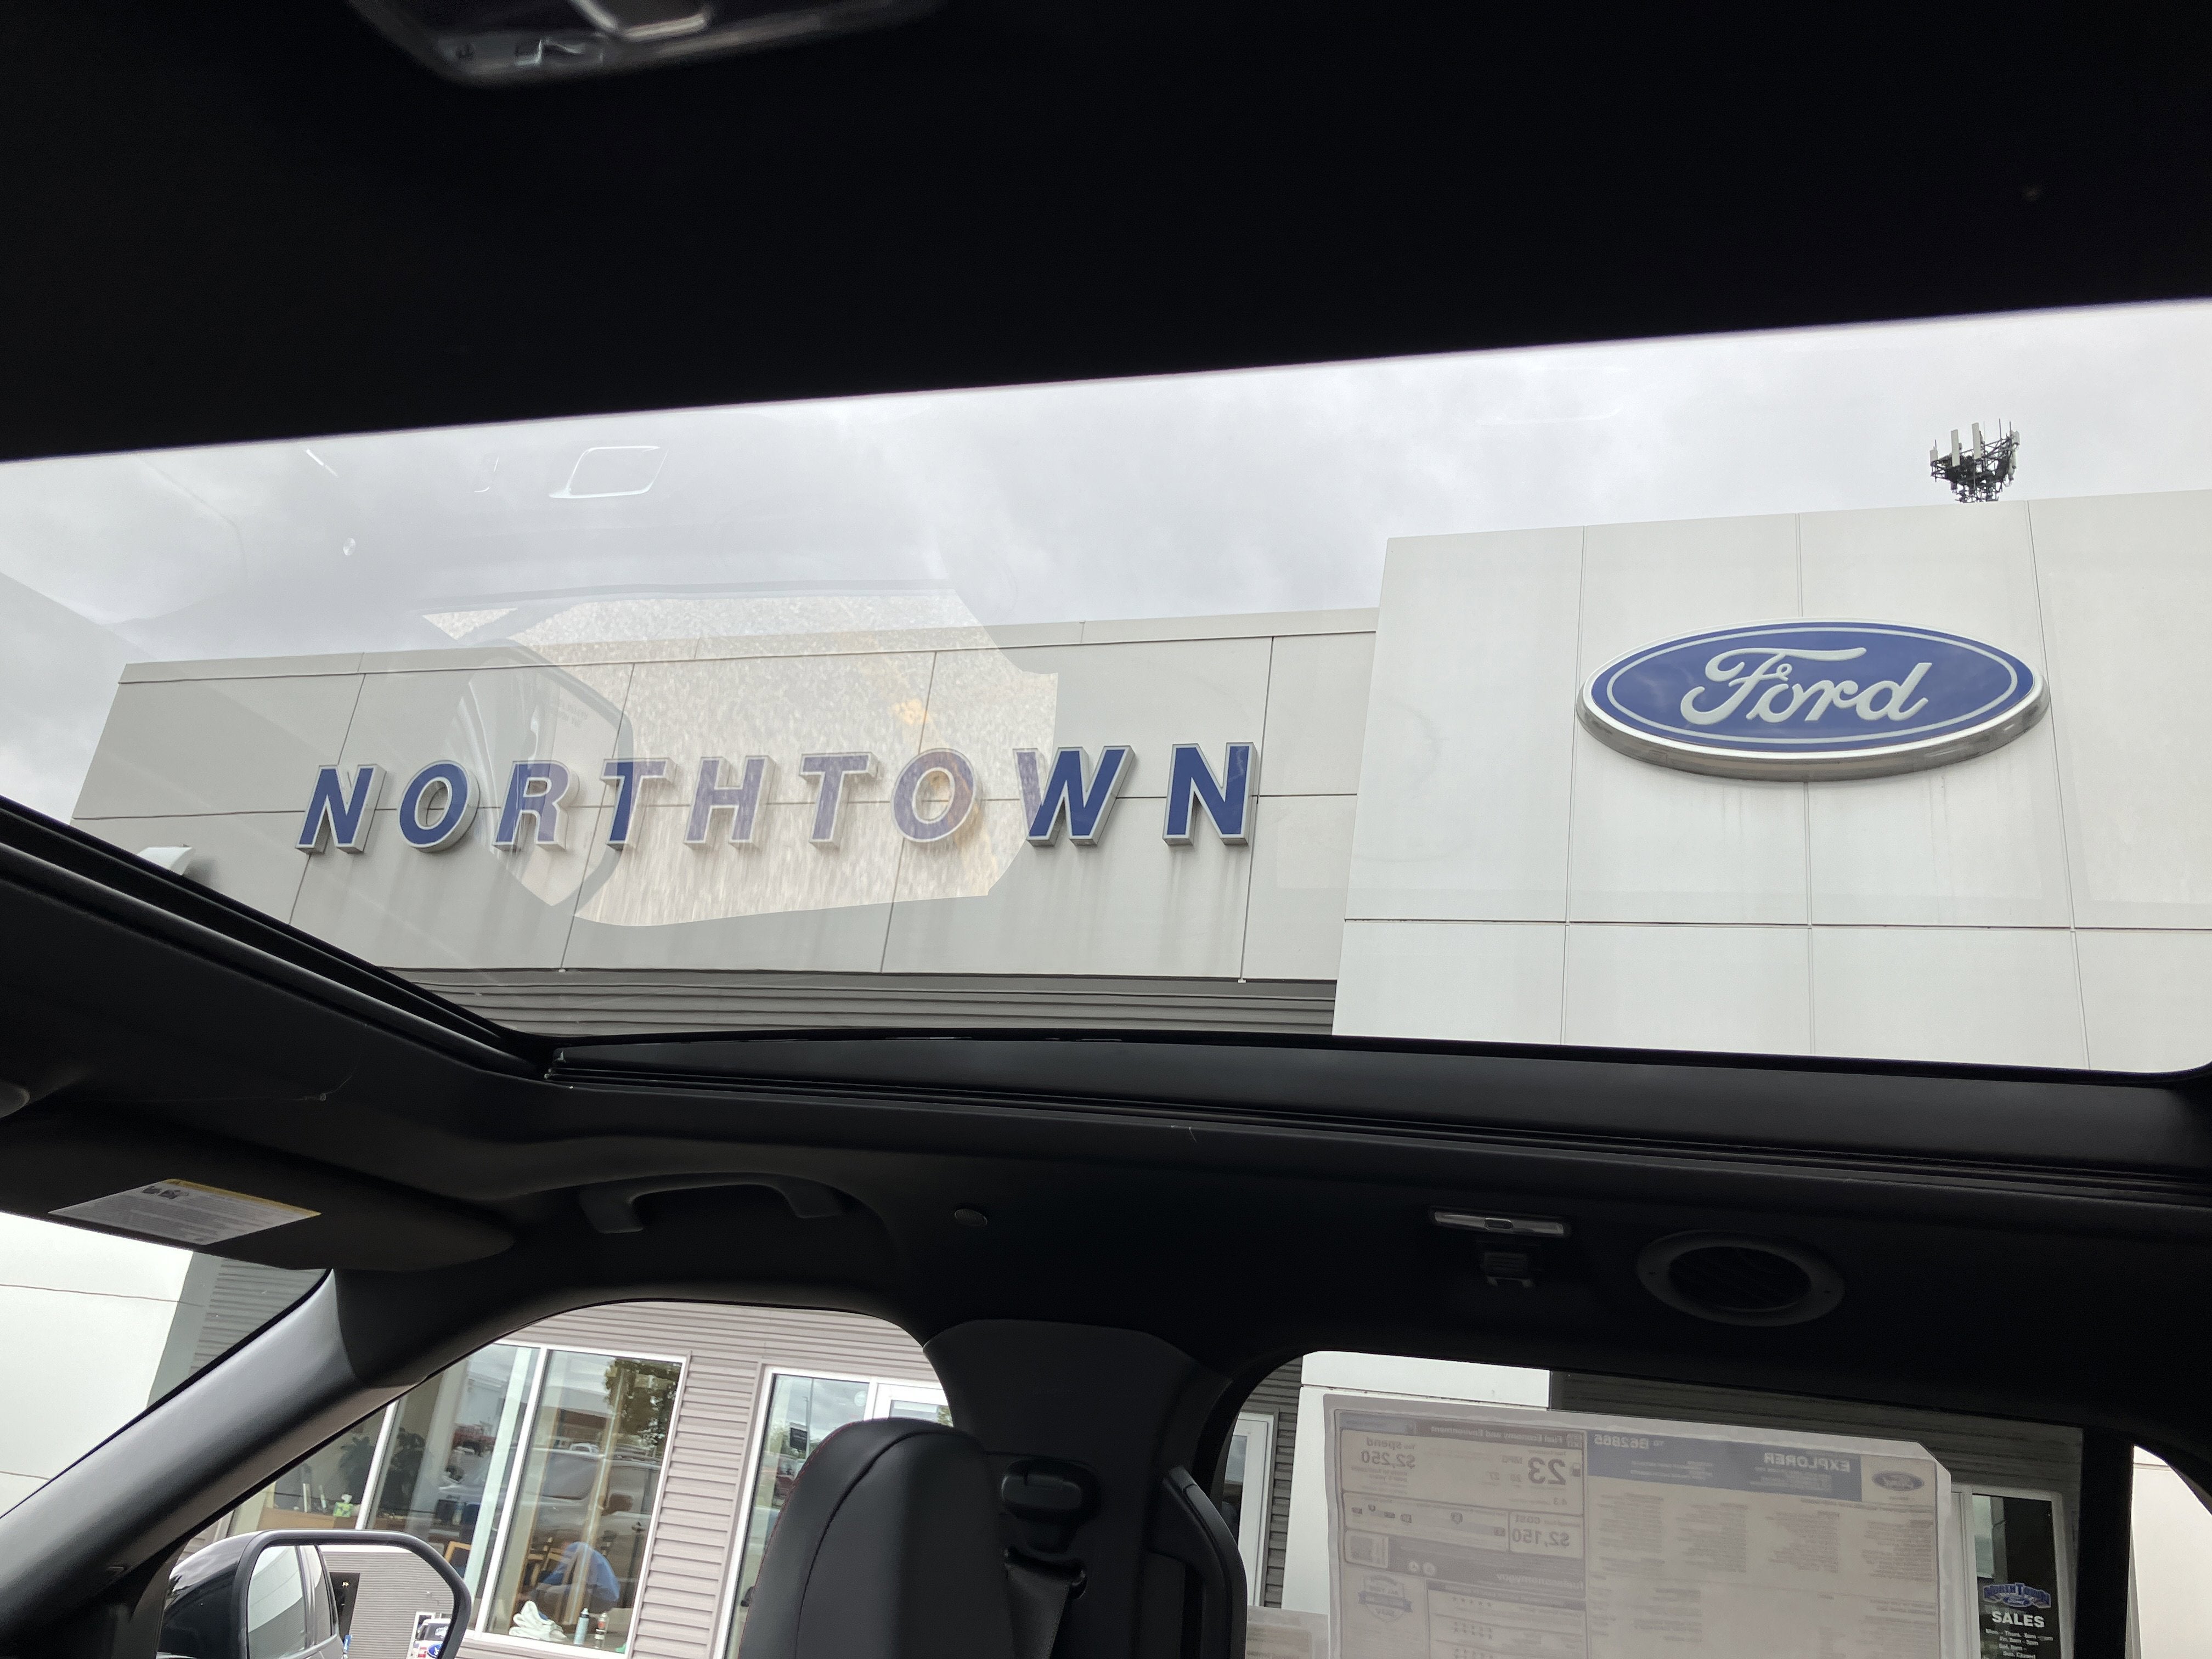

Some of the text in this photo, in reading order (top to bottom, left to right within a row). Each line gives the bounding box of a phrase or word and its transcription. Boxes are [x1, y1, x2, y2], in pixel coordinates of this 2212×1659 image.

[1680, 647, 1932, 725] Ford
[295, 742, 1257, 853] NORTHTOWN
[1992, 1611, 2045, 1628] SALES
